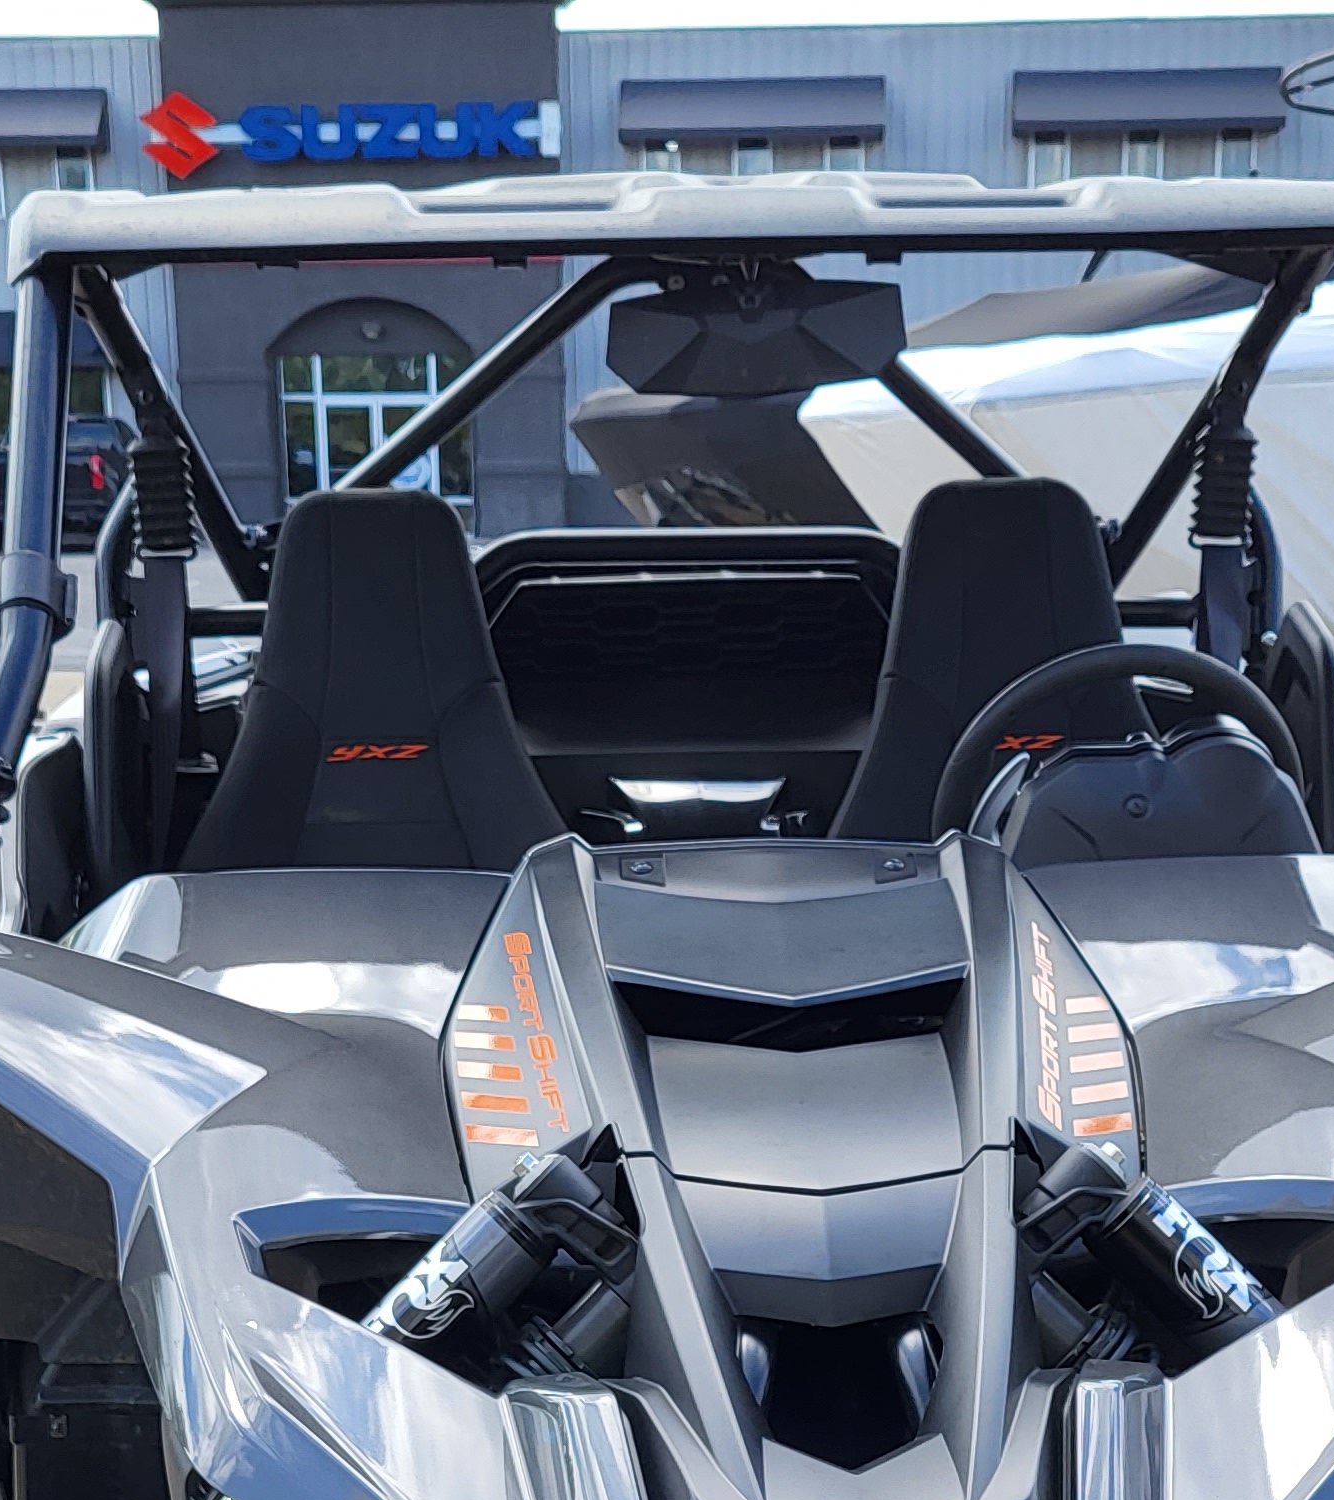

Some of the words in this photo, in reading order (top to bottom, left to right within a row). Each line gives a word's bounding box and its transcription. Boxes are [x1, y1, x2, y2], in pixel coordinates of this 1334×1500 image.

[326, 743, 429, 762] YXZ
[994, 734, 1065, 750] XZ
[1031, 920, 1057, 1016] SHIFT
[503, 931, 544, 1031] SPORT
[527, 1034, 570, 1133] SHIFT
[1037, 1007, 1063, 1132] SPORT
[1152, 1195, 1263, 1313] FOX
